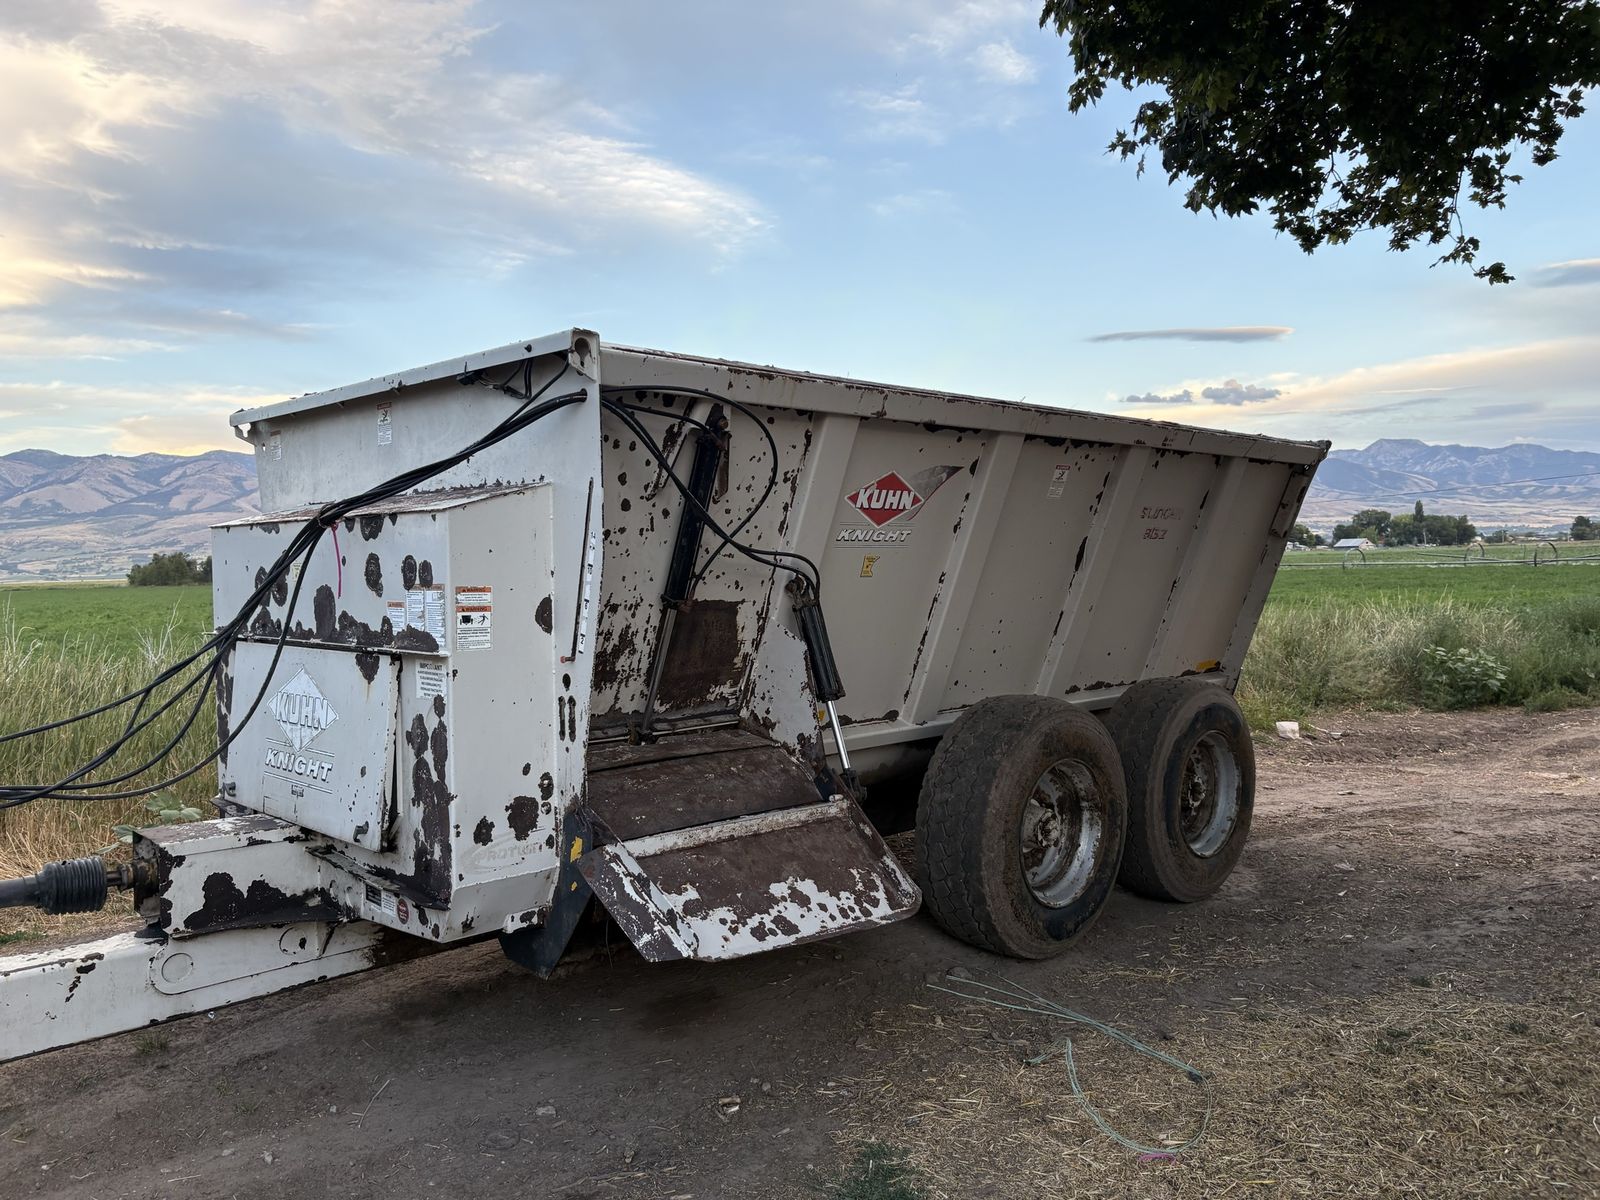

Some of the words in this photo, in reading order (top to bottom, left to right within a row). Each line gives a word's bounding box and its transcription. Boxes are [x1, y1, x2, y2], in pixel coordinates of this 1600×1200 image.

[855, 488, 915, 511] KUHN
[836, 529, 912, 542] KNIGHT
[275, 691, 329, 731] KUHN
[264, 747, 333, 782] KNIGHT
